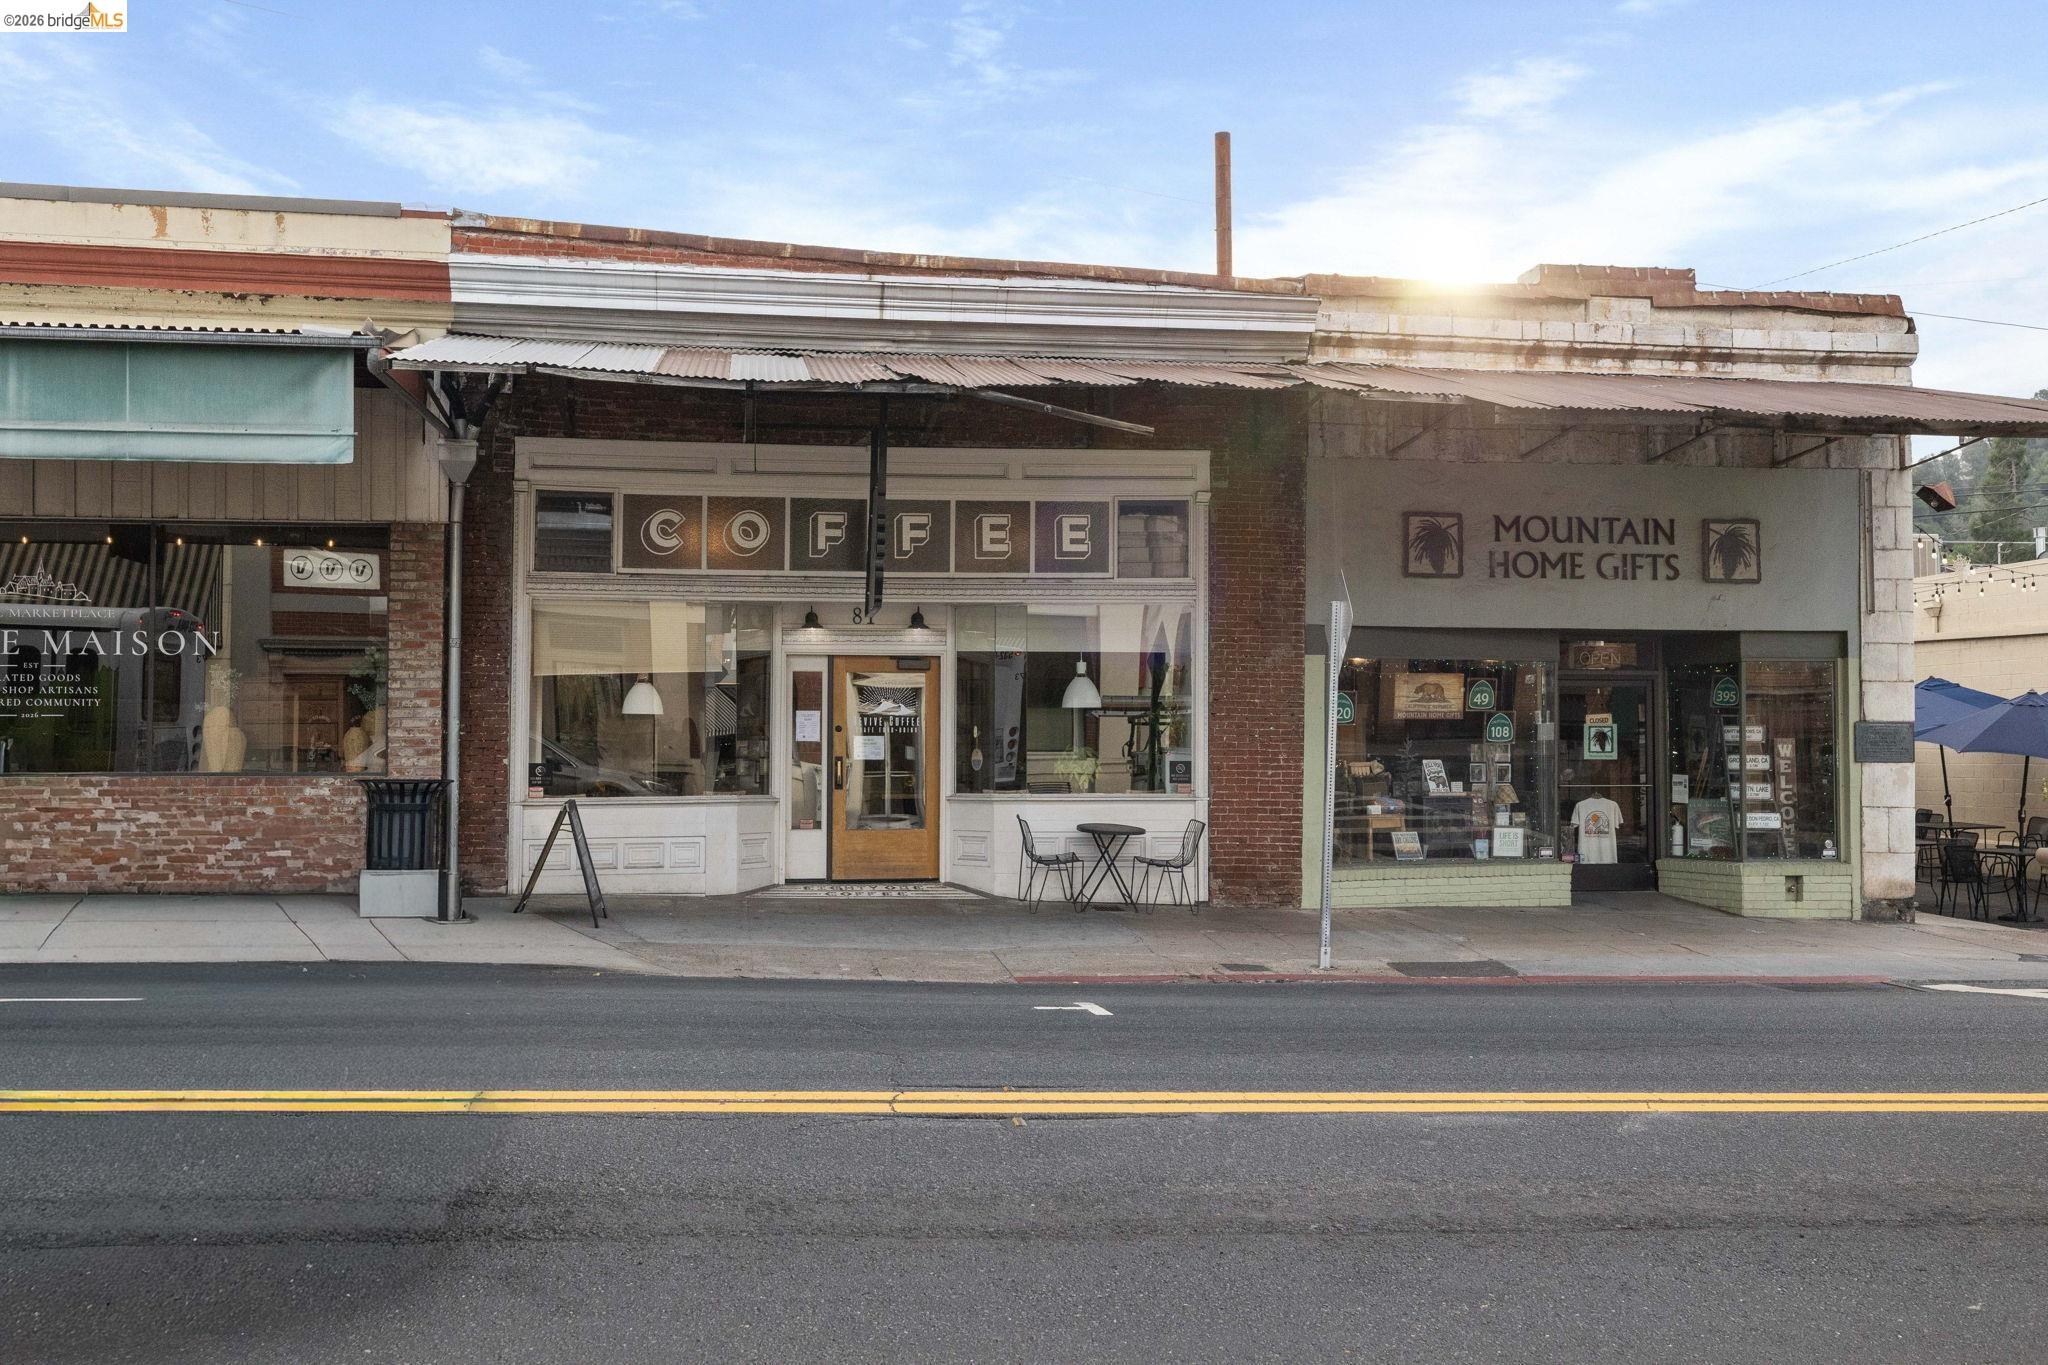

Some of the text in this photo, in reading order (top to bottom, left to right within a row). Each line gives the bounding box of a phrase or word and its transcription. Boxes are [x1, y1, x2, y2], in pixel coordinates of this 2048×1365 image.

[640, 508, 1092, 560] COFFEE
[1492, 514, 1676, 545] MOUNTAIN
[1489, 550, 1681, 581] HOME GIFTS
[9, 608, 115, 618] MARKETPLACE
[41, 630, 217, 656] MAISON
[1580, 651, 1621, 666] OPEN
[0, 673, 81, 682] ATED GOODS
[2, 685, 99, 694] SHOP ARTISANS
[1473, 692, 1489, 705] 49
[1717, 690, 1736, 702] 395
[25, 698, 101, 707] COMMUNITY
[1336, 707, 1351, 719] 20
[1491, 726, 1510, 738] 108
[1778, 744, 1797, 853] WELCOME
[1500, 831, 1519, 840] LIFE IS
